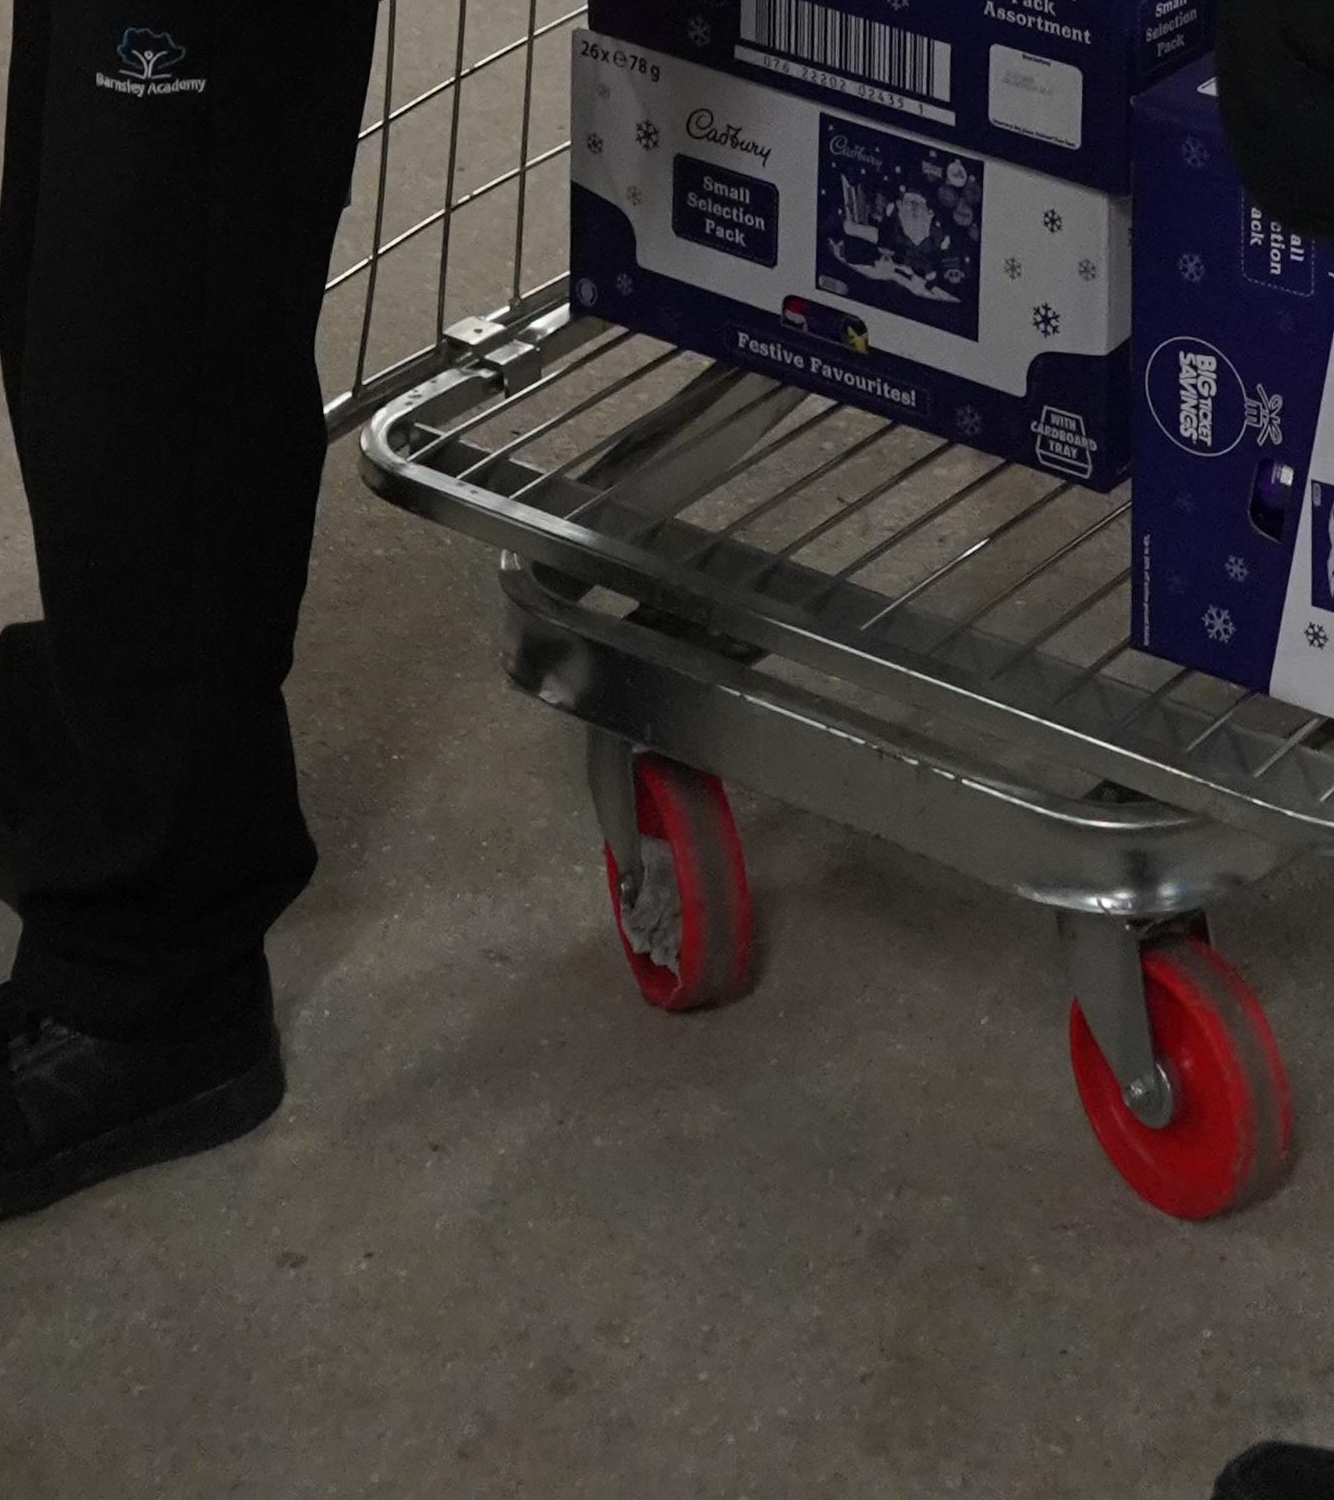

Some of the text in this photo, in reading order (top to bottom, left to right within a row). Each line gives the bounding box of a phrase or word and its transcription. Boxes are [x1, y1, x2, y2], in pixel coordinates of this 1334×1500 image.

[983, 0, 1091, 45] Assortment
[1145, 7, 1197, 43] Selection
[1156, 33, 1185, 57] Pack
[96, 72, 206, 97] Barnsley Academy
[686, 108, 771, 167] Cadbury
[702, 175, 751, 204] Small
[686, 191, 766, 232] Selection
[1250, 207, 1265, 246] ack
[704, 219, 747, 248] Pack
[737, 331, 916, 407] Festive Favourites!
[1179, 350, 1198, 444] SAVINGS
[1195, 353, 1217, 448] BIG TICKET
[1030, 420, 1098, 451] CARDBOARD
[1050, 413, 1077, 431] WITH
[1048, 440, 1078, 460] TRAY
